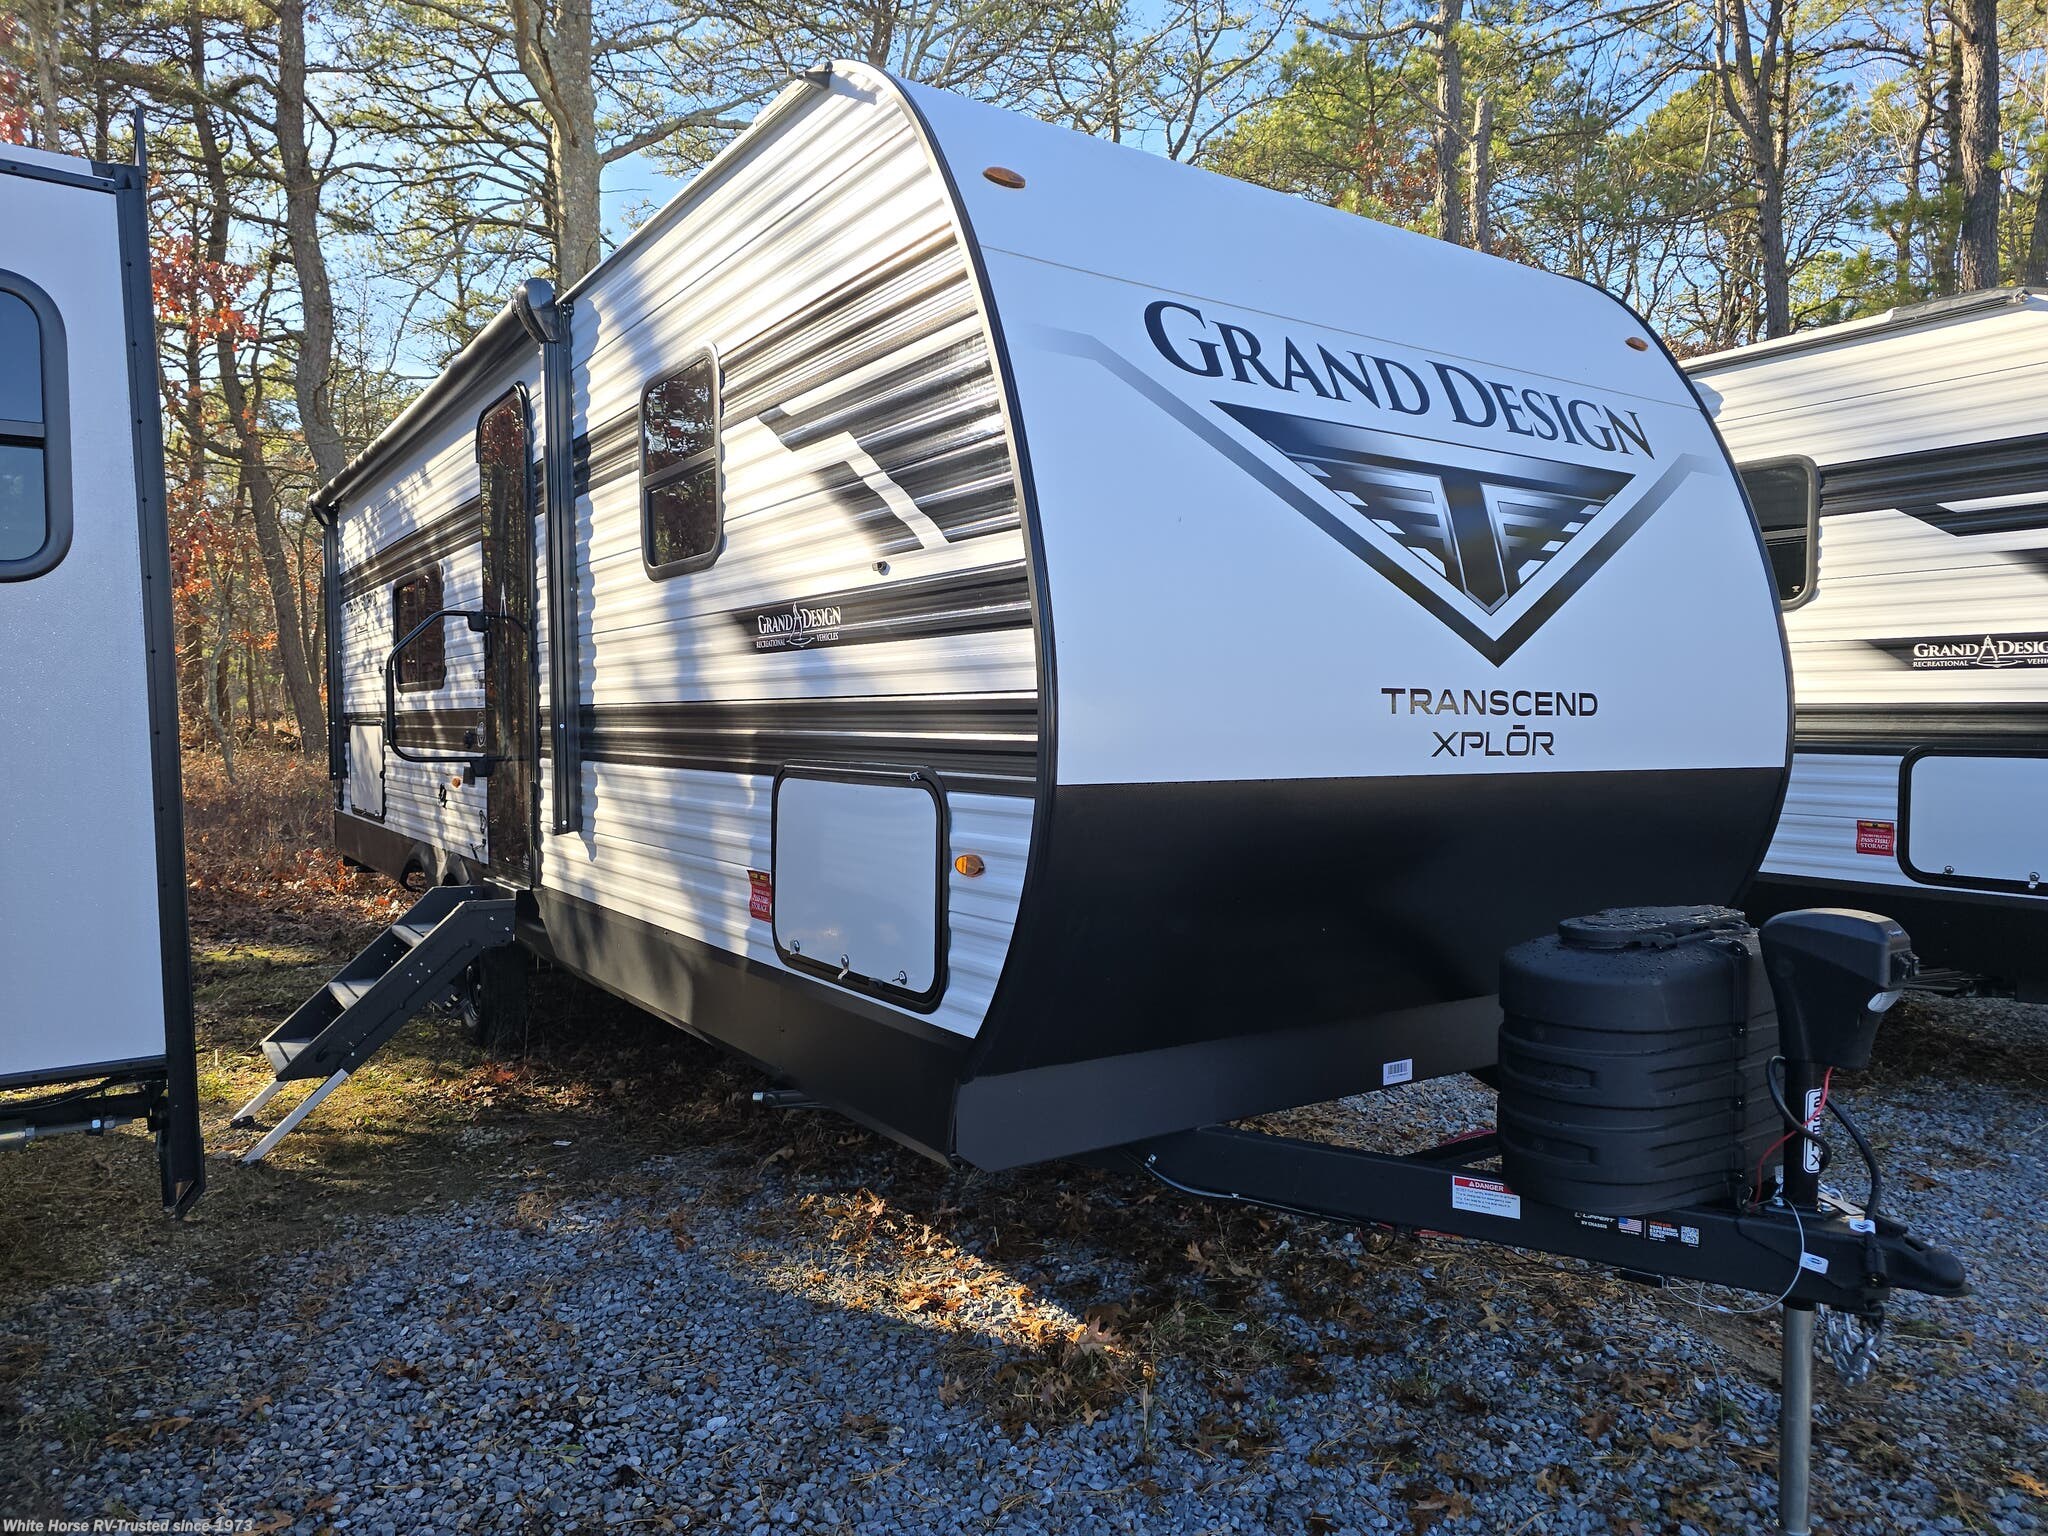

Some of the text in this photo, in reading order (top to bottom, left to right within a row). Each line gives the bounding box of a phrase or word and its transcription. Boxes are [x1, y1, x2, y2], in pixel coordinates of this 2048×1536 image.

[1143, 300, 1656, 460] GRAND DESIGN
[757, 606, 841, 634] GRAND DESIGN
[816, 631, 839, 642] VEHICLES
[1913, 643, 1979, 658] GRAND
[1912, 660, 1969, 668] RECREATIONAL
[1381, 687, 1599, 717] TRANSCEND
[1474, 1181, 1505, 1192] DANGER
[1582, 1213, 1616, 1223] LIPPERT
[1588, 1221, 1608, 1229] CHASSIS
